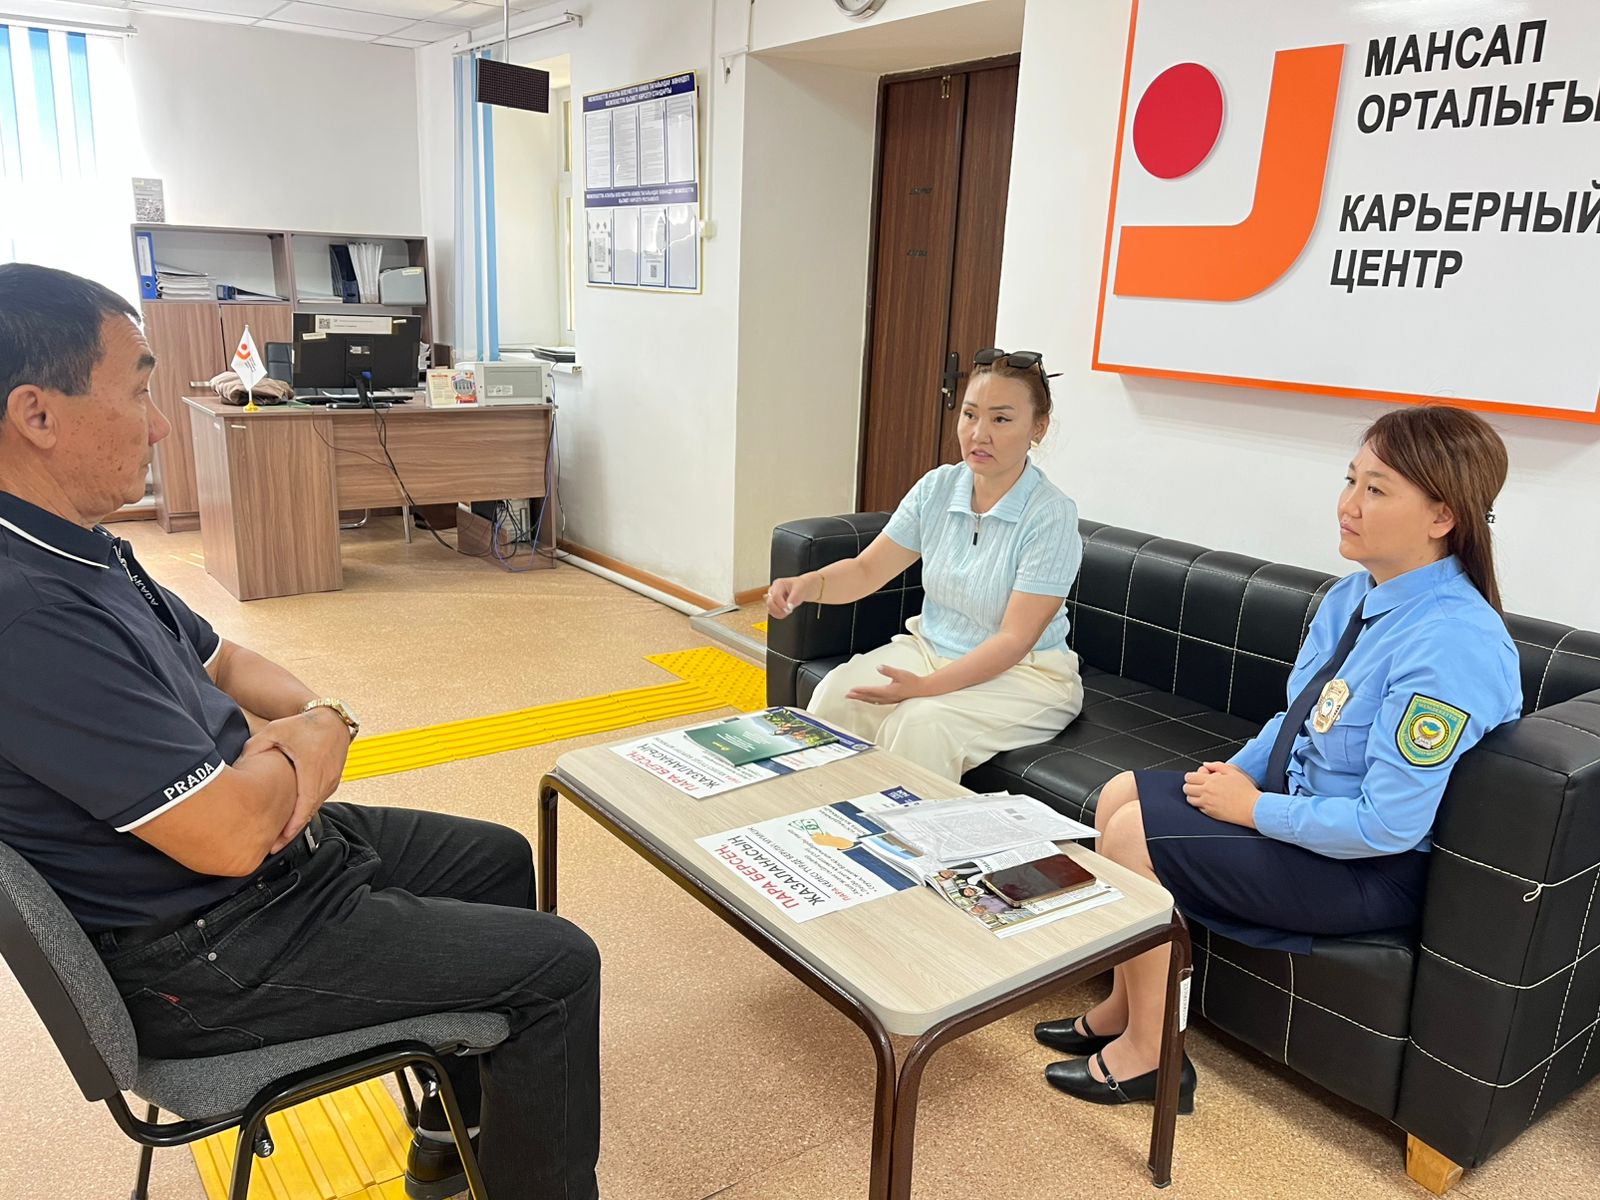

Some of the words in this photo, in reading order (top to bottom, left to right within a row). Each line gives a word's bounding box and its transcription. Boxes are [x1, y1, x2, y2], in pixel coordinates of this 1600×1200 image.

[1365, 19, 1547, 77] МАНСАП
[1357, 80, 1600, 134] ОРТАЛЫҒЫ
[1339, 179, 1600, 233] КАРЬЕРНЫЙ
[1330, 249, 1463, 293] ЦЕНТР
[163, 762, 215, 801] PRADA
[761, 881, 800, 908] ПАРА
[830, 887, 852, 901] ПАРА
